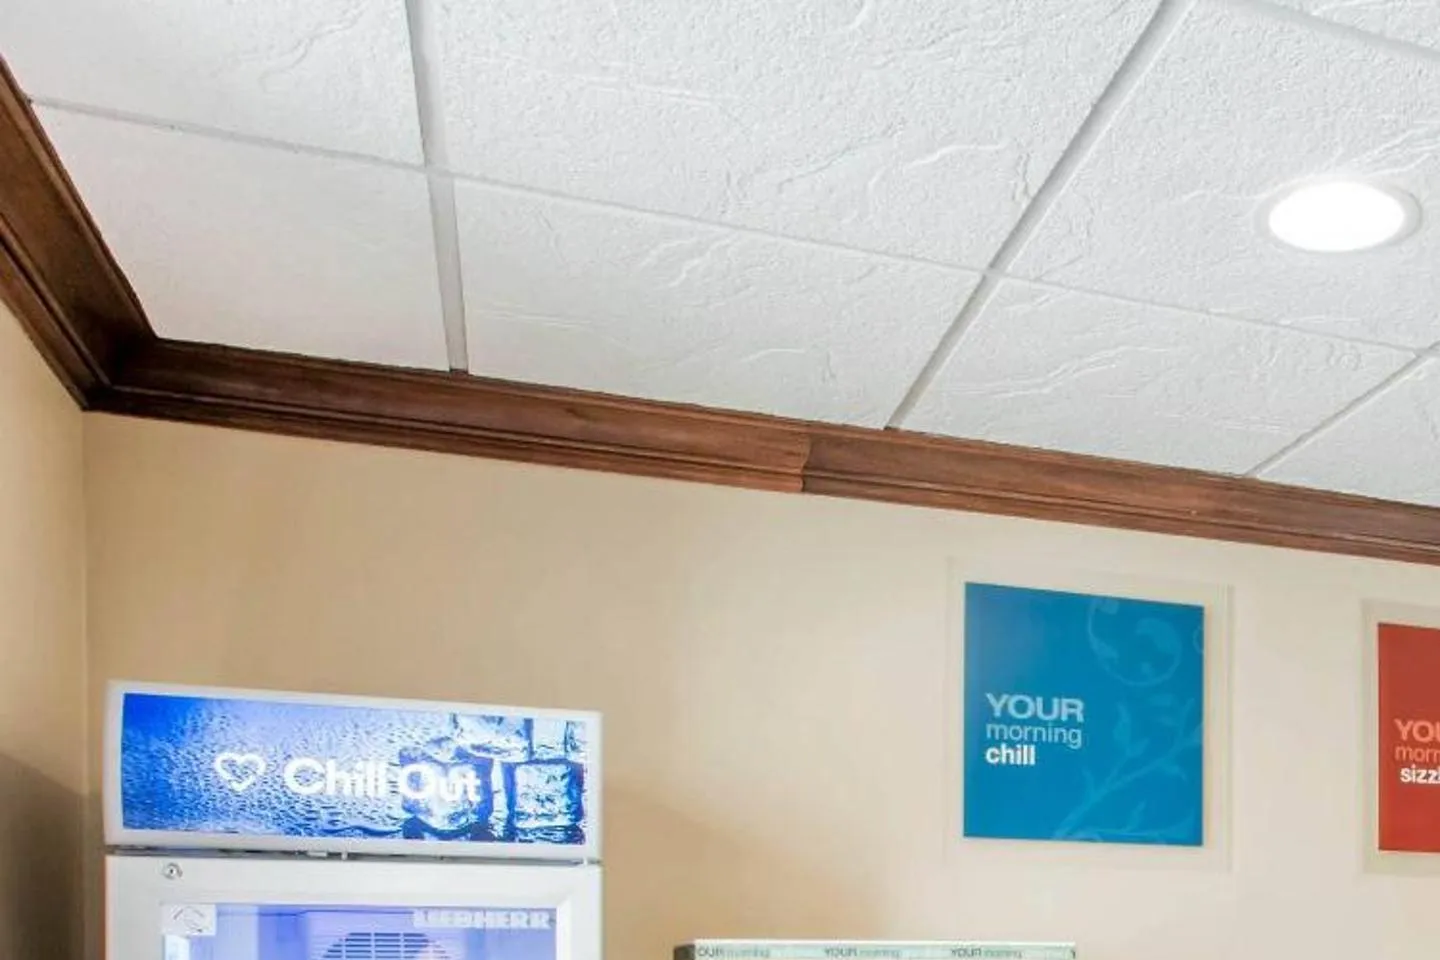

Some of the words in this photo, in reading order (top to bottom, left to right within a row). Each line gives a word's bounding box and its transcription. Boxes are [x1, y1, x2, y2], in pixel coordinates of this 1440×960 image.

[985, 693, 1084, 722] YOUR
[986, 722, 1082, 749] morning
[985, 744, 1036, 765] chill
[284, 757, 387, 801] Chill
[400, 762, 482, 804] Out
[825, 946, 857, 957] YOUR
[951, 947, 981, 958] YOUR
